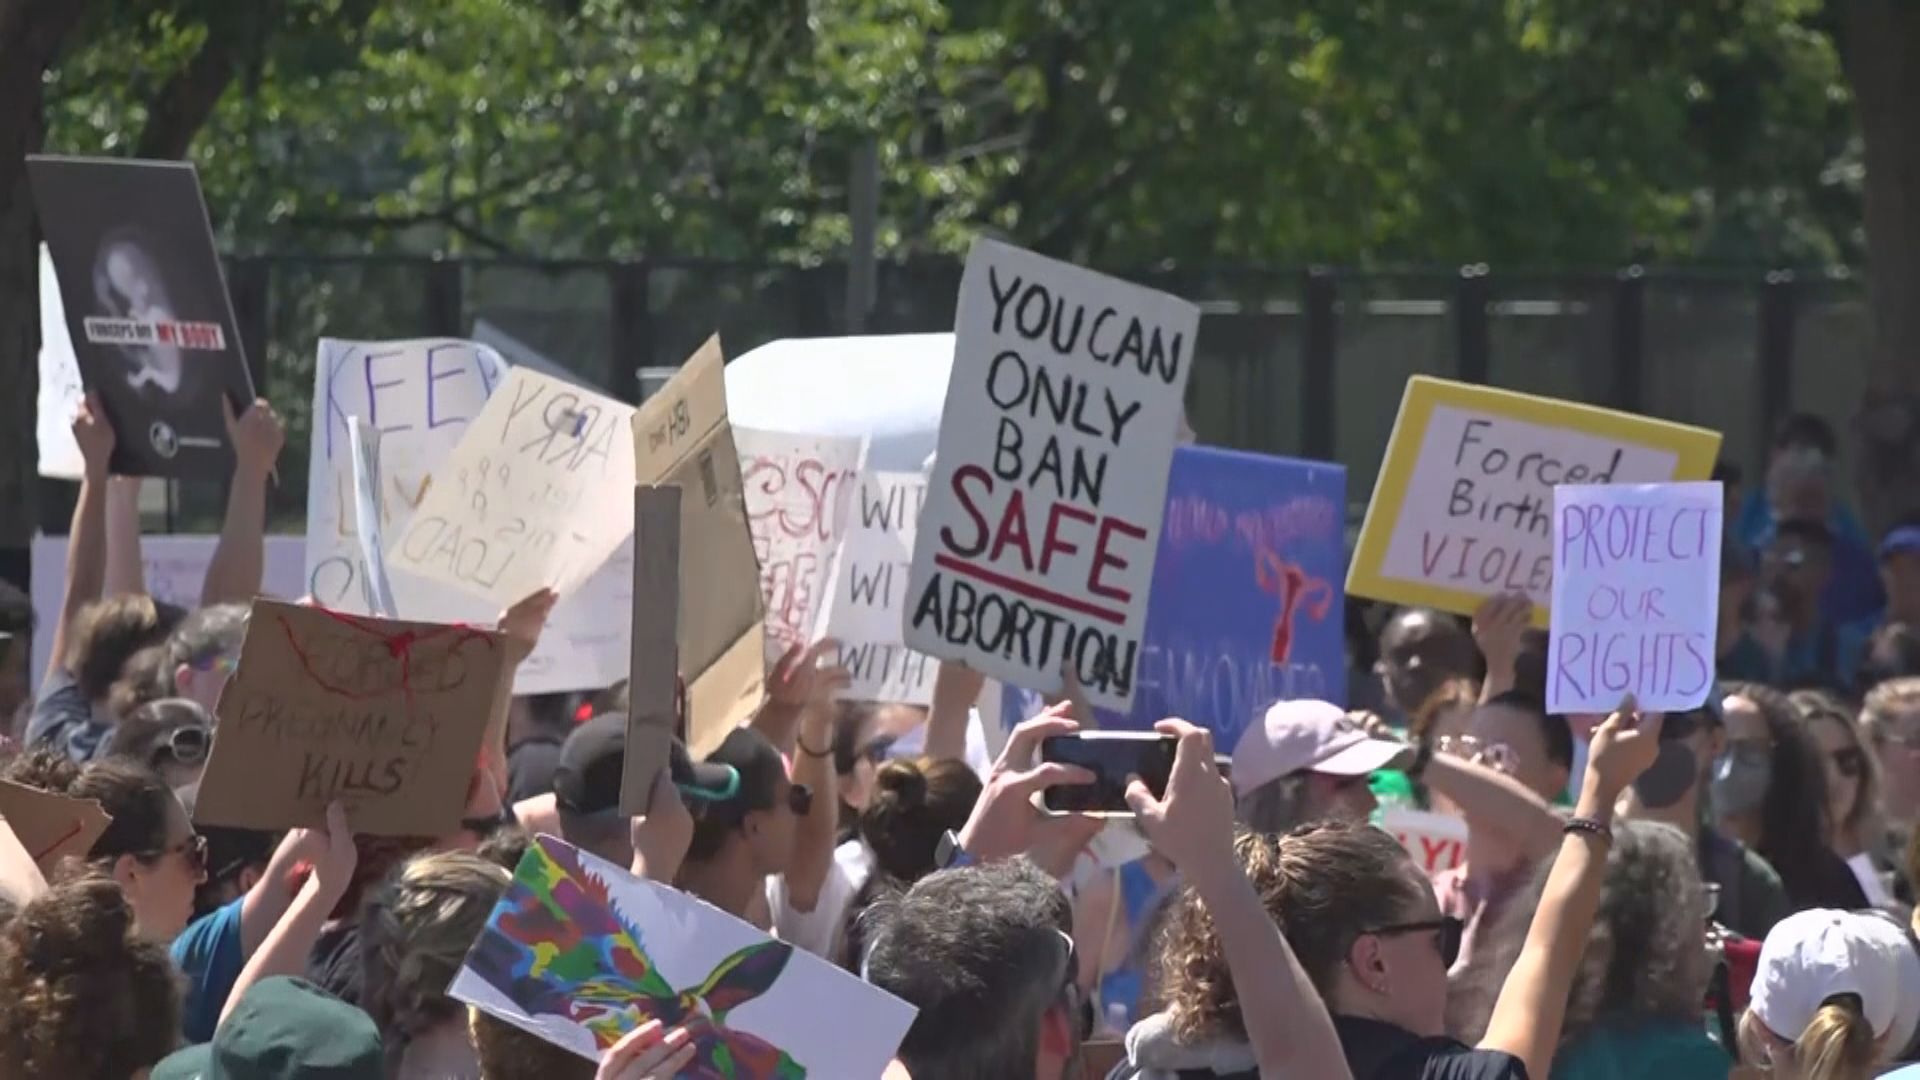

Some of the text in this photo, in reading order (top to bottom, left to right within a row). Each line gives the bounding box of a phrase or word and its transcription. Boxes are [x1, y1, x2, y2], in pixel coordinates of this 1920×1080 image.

[156, 322, 177, 345] MY
[180, 322, 219, 348] BODY
[988, 265, 1183, 384] YOU CAN
[987, 351, 1141, 447] ONLY
[993, 416, 1107, 507] BAN
[1455, 420, 1622, 485] Forced
[940, 464, 1147, 603] SAFE
[1448, 479, 1549, 537] Birth
[1562, 503, 1710, 570] PROTECT
[912, 573, 1137, 697] ABORTION
[1587, 587, 1665, 622] OUR
[838, 642, 926, 688] WITH
[1554, 632, 1707, 706] RIGHTS
[297, 750, 407, 800] KILLS
